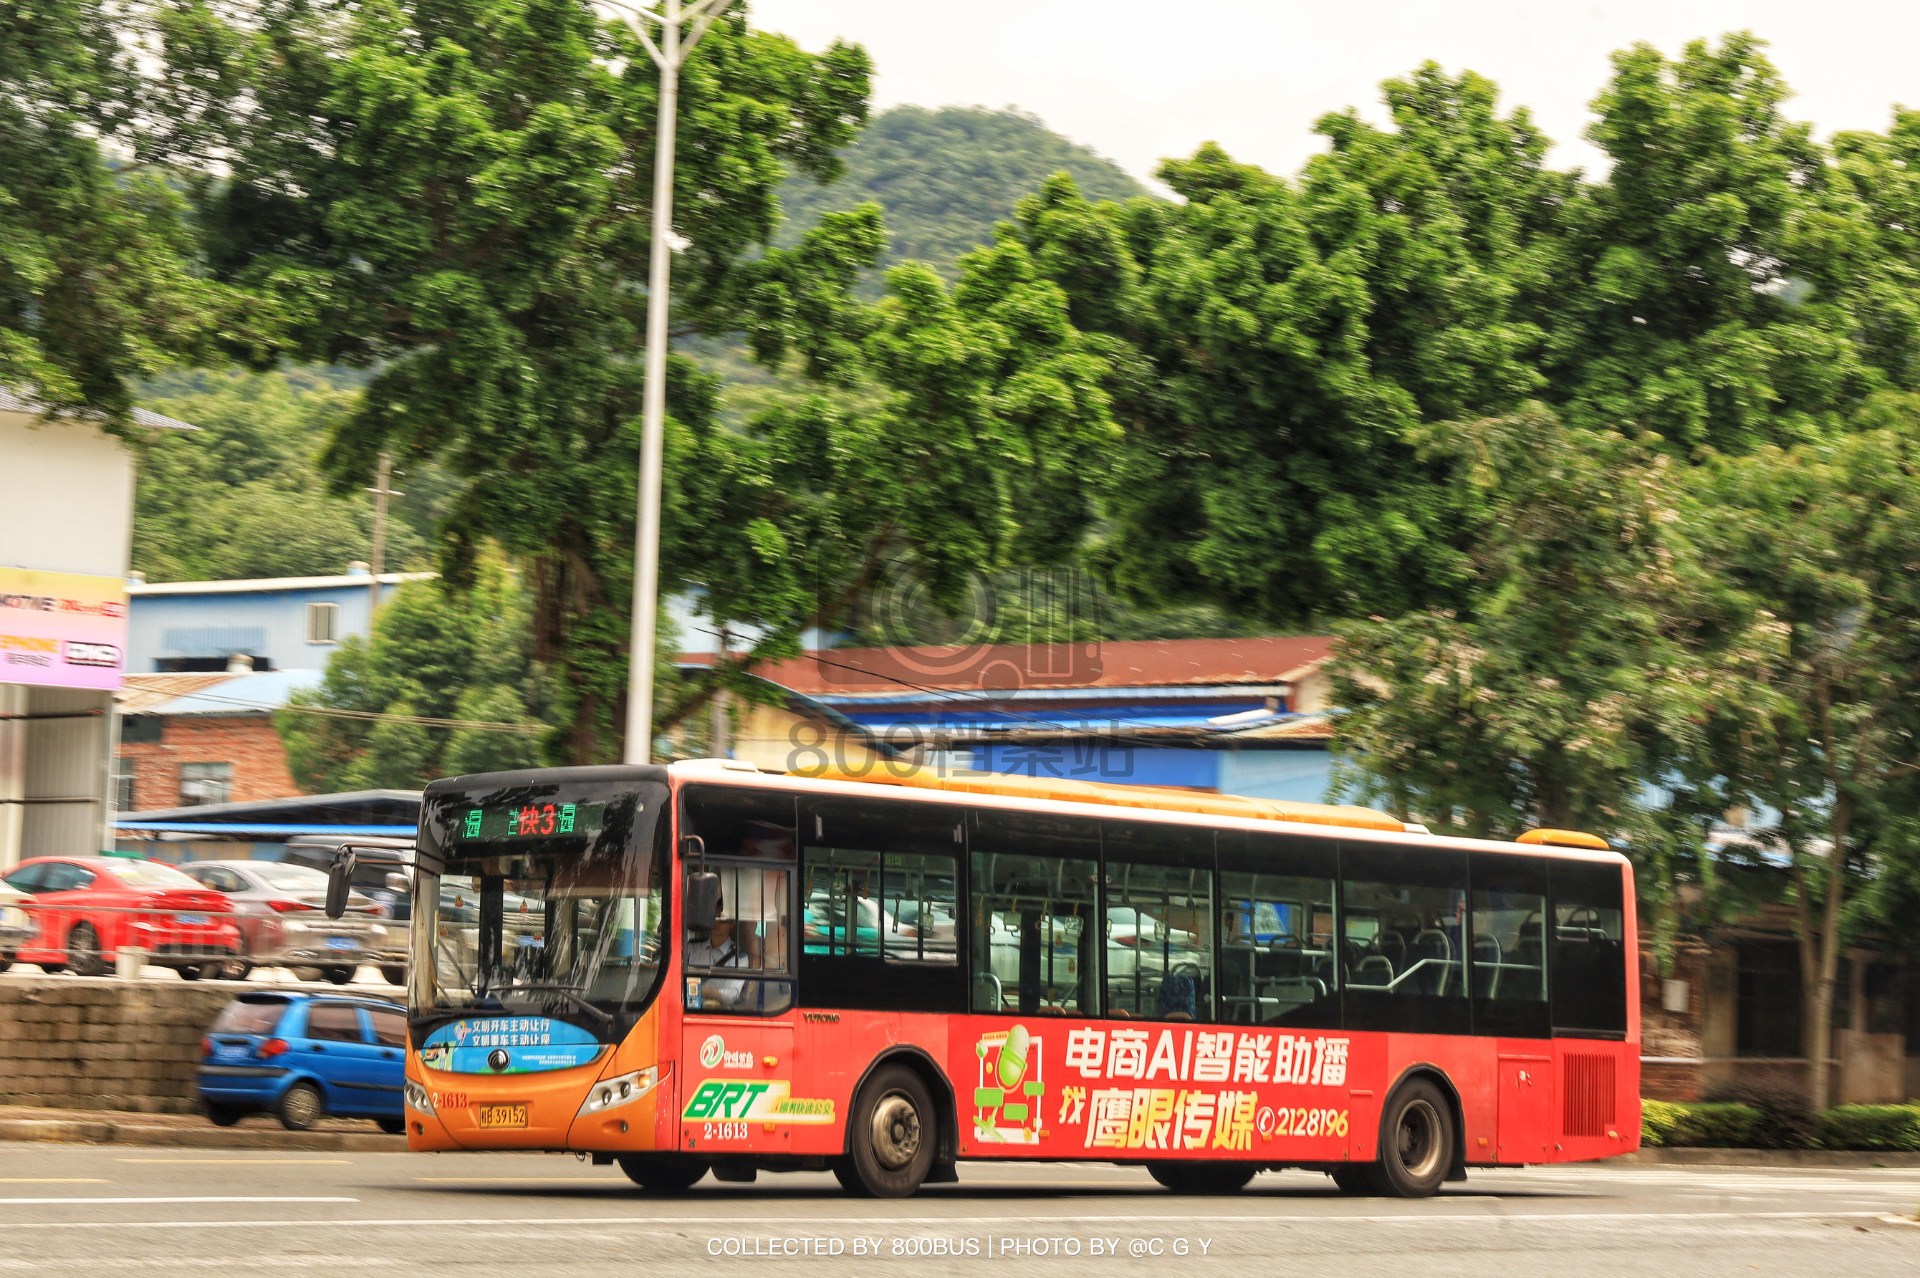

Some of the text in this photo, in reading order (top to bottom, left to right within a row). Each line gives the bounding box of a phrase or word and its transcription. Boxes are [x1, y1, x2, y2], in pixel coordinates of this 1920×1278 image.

[472, 1019, 551, 1034] 文明开车主动让行
[472, 1034, 551, 1047] 文明乘车主动让座
[1066, 1027, 1350, 1086] 电商AI智能助播
[432, 1092, 468, 1109] 2-1613
[684, 1083, 770, 1118] BRT
[704, 1121, 749, 1140] 2-1613
[1275, 1107, 1349, 1138] 2128196
